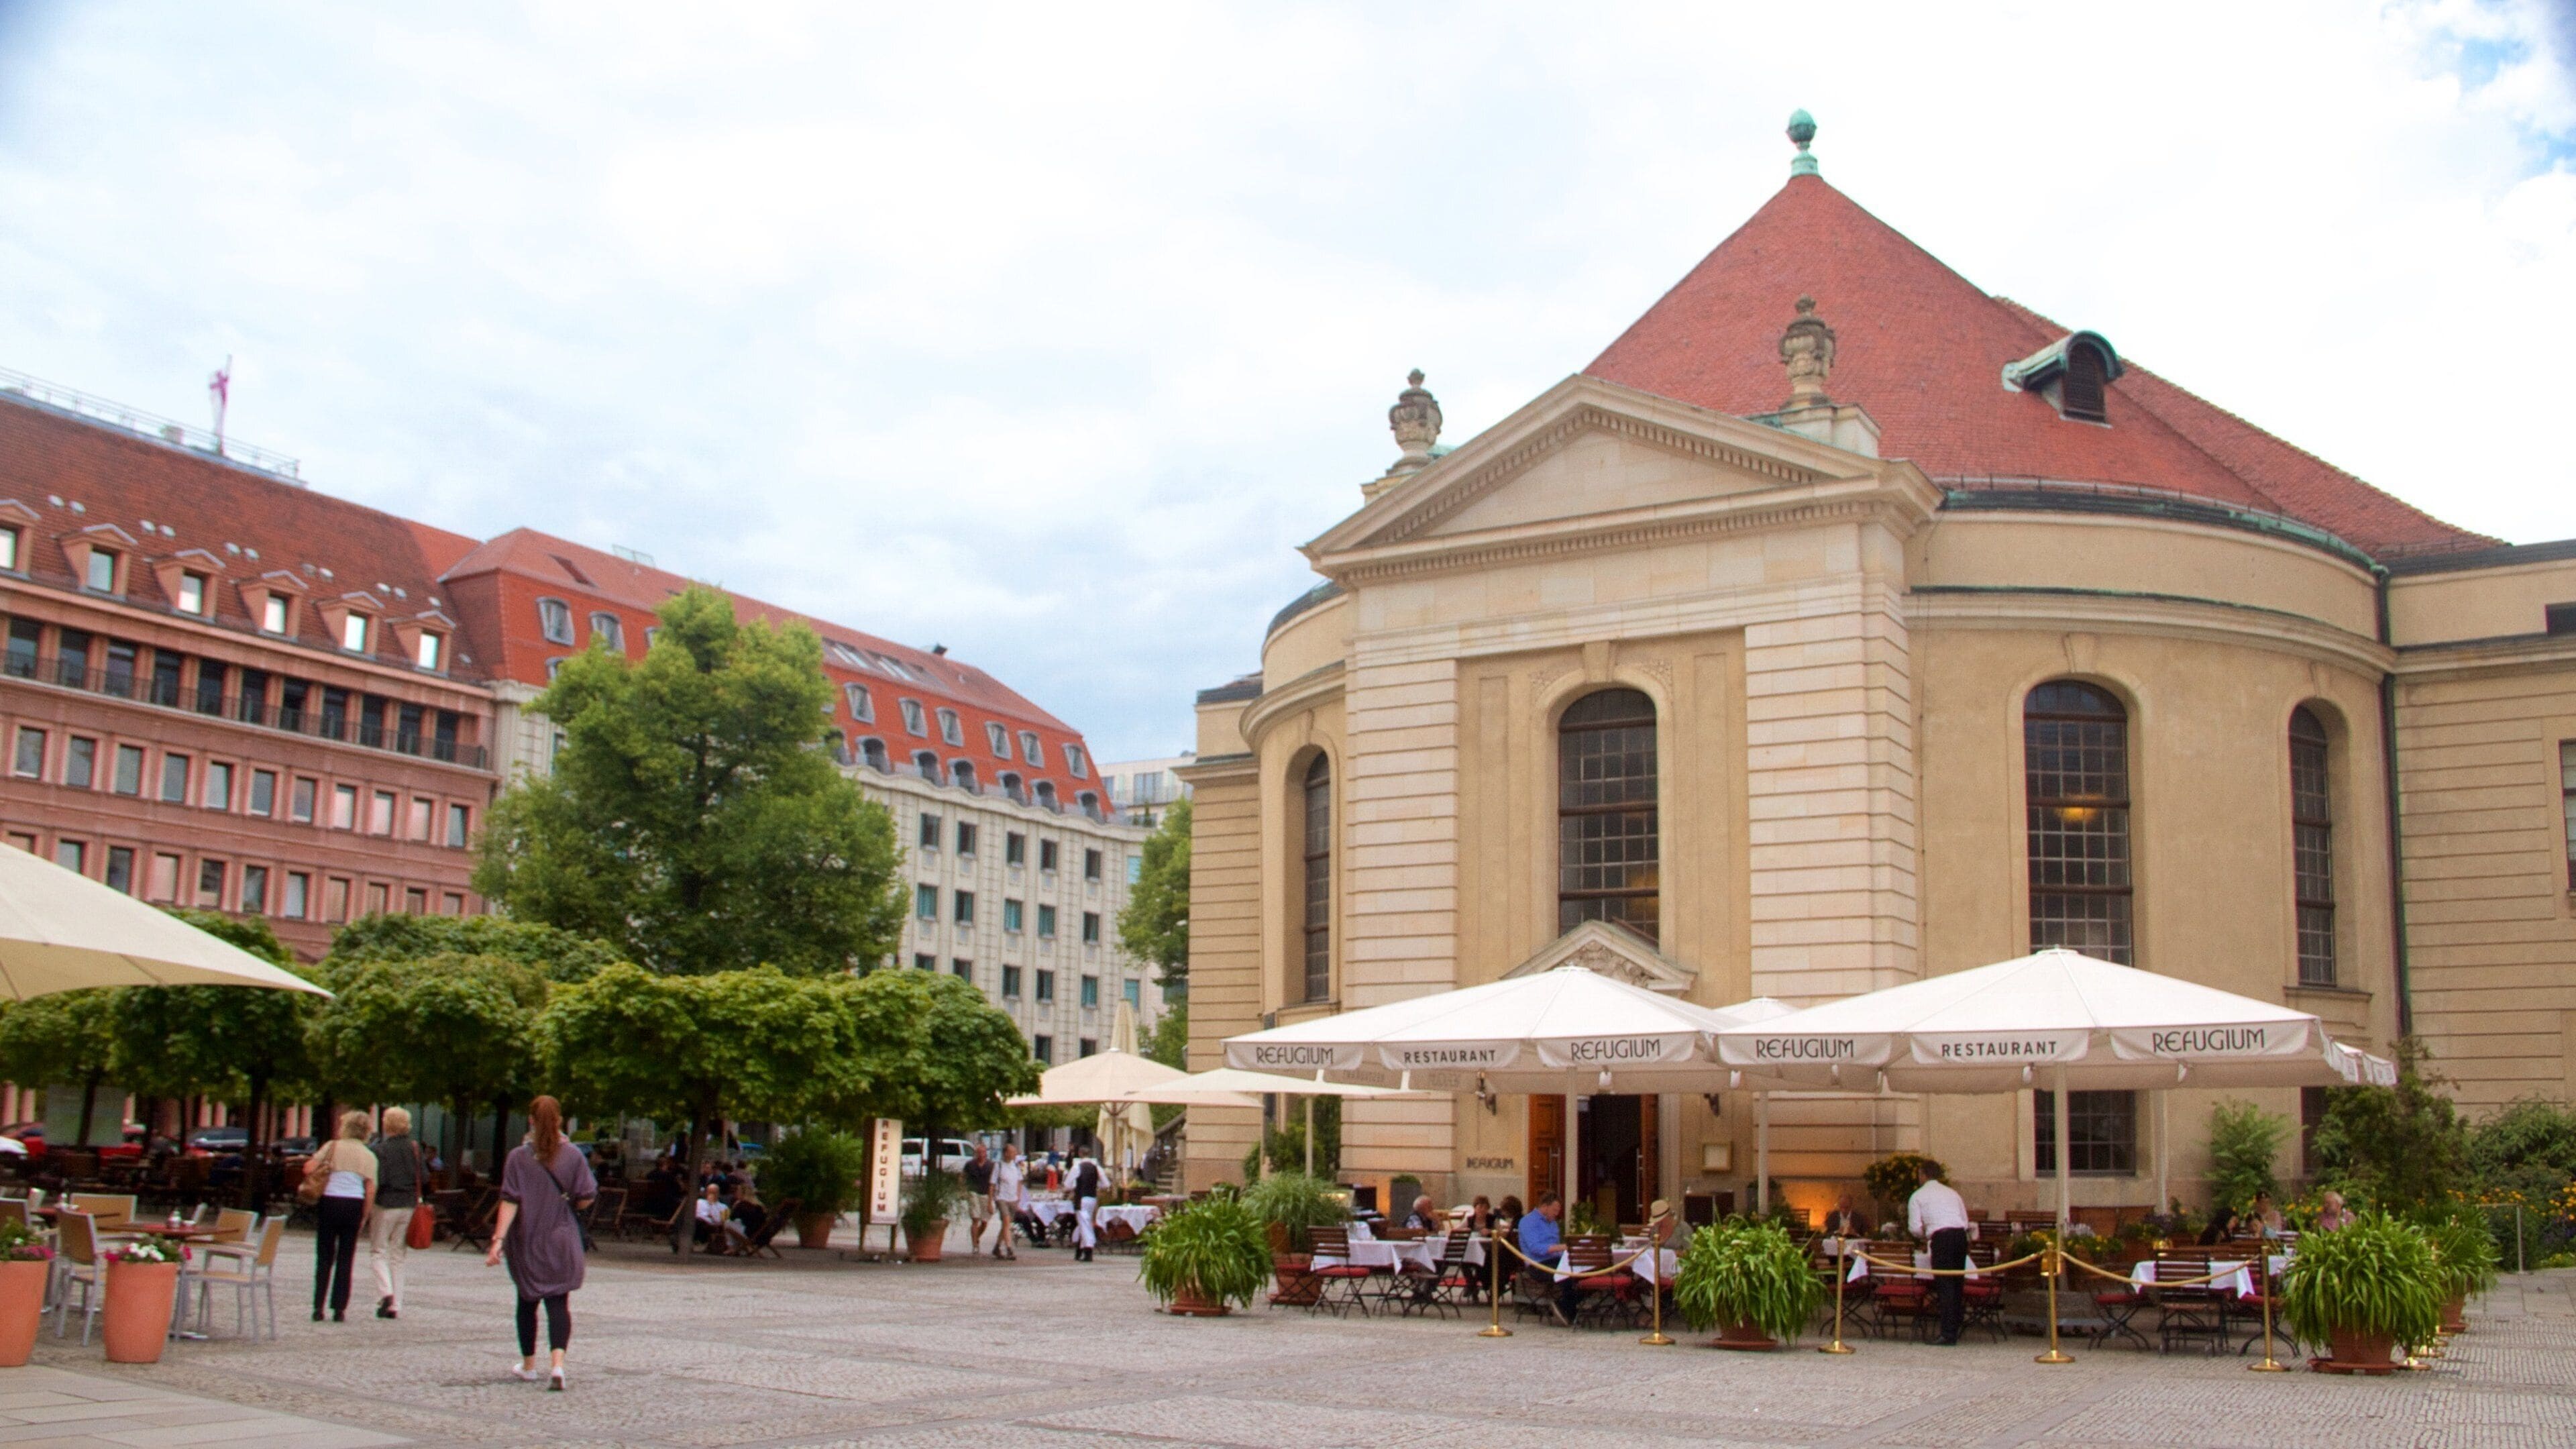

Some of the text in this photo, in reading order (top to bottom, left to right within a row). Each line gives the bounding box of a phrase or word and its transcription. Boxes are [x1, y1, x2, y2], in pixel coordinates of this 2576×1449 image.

[1570, 1038, 1661, 1061] REFUGIUM
[1755, 1038, 1854, 1059] REFUGIUM
[1941, 1040, 2057, 1057] RESTAURANT
[2152, 1028, 2265, 1053] REFUGIUM
[1256, 1046, 1334, 1065] REFUGIUM
[1403, 1049, 1496, 1063] RESTAURANT
[876, 1120, 890, 1212] REFUGIUM
